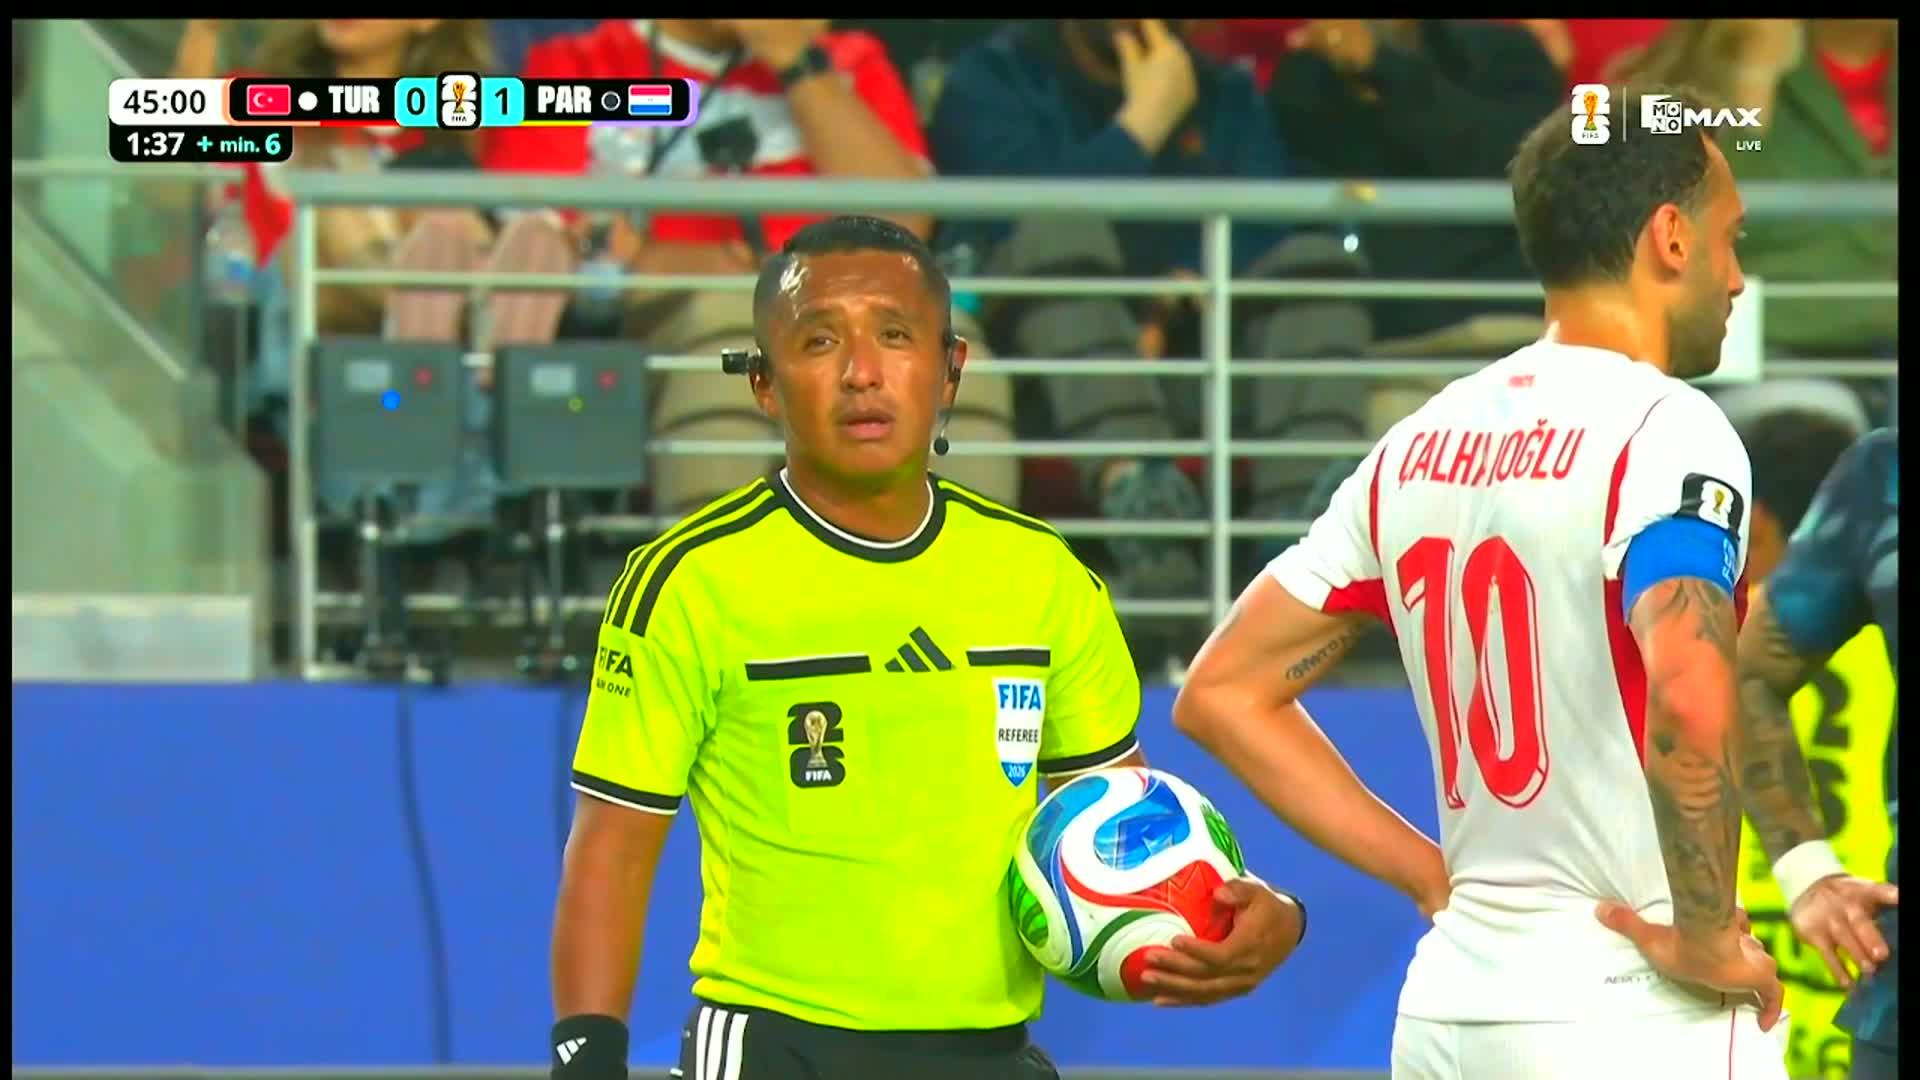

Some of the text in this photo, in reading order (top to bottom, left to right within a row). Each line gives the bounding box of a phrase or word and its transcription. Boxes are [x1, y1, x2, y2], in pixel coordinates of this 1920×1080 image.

[1396, 535, 1550, 810] 10
[998, 684, 1042, 711] FIFA
[998, 728, 1039, 743] REFEREE
[805, 769, 832, 781] FIFA
[1009, 764, 1026, 778] 2026
